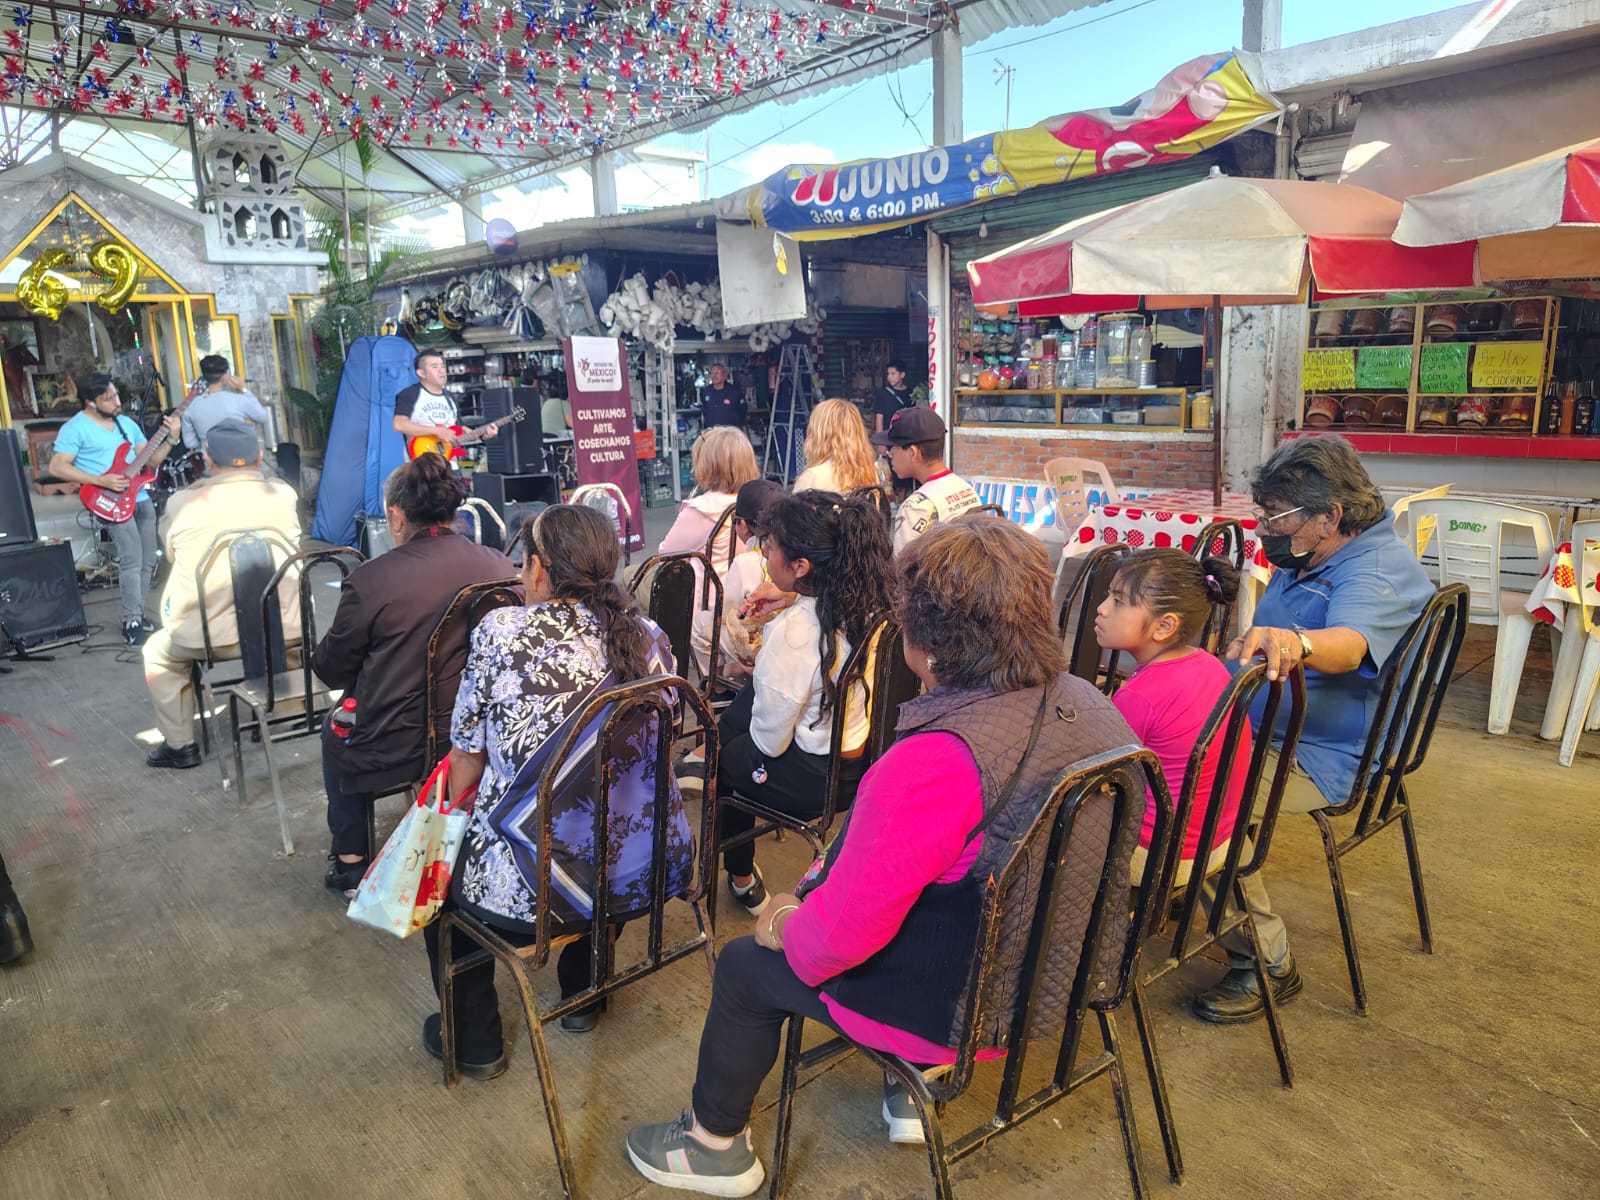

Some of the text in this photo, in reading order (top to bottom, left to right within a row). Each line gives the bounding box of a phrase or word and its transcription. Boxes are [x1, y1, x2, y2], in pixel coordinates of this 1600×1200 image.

[839, 149, 949, 202] JUNIO
[809, 191, 946, 224] 3:00 & 6:00 PM.
[577, 408, 627, 420] CULTIVAMOS
[593, 422, 616, 434] ARTE,
[578, 435, 631, 449] COSECHAMOS
[590, 450, 625, 463] CULTURA
